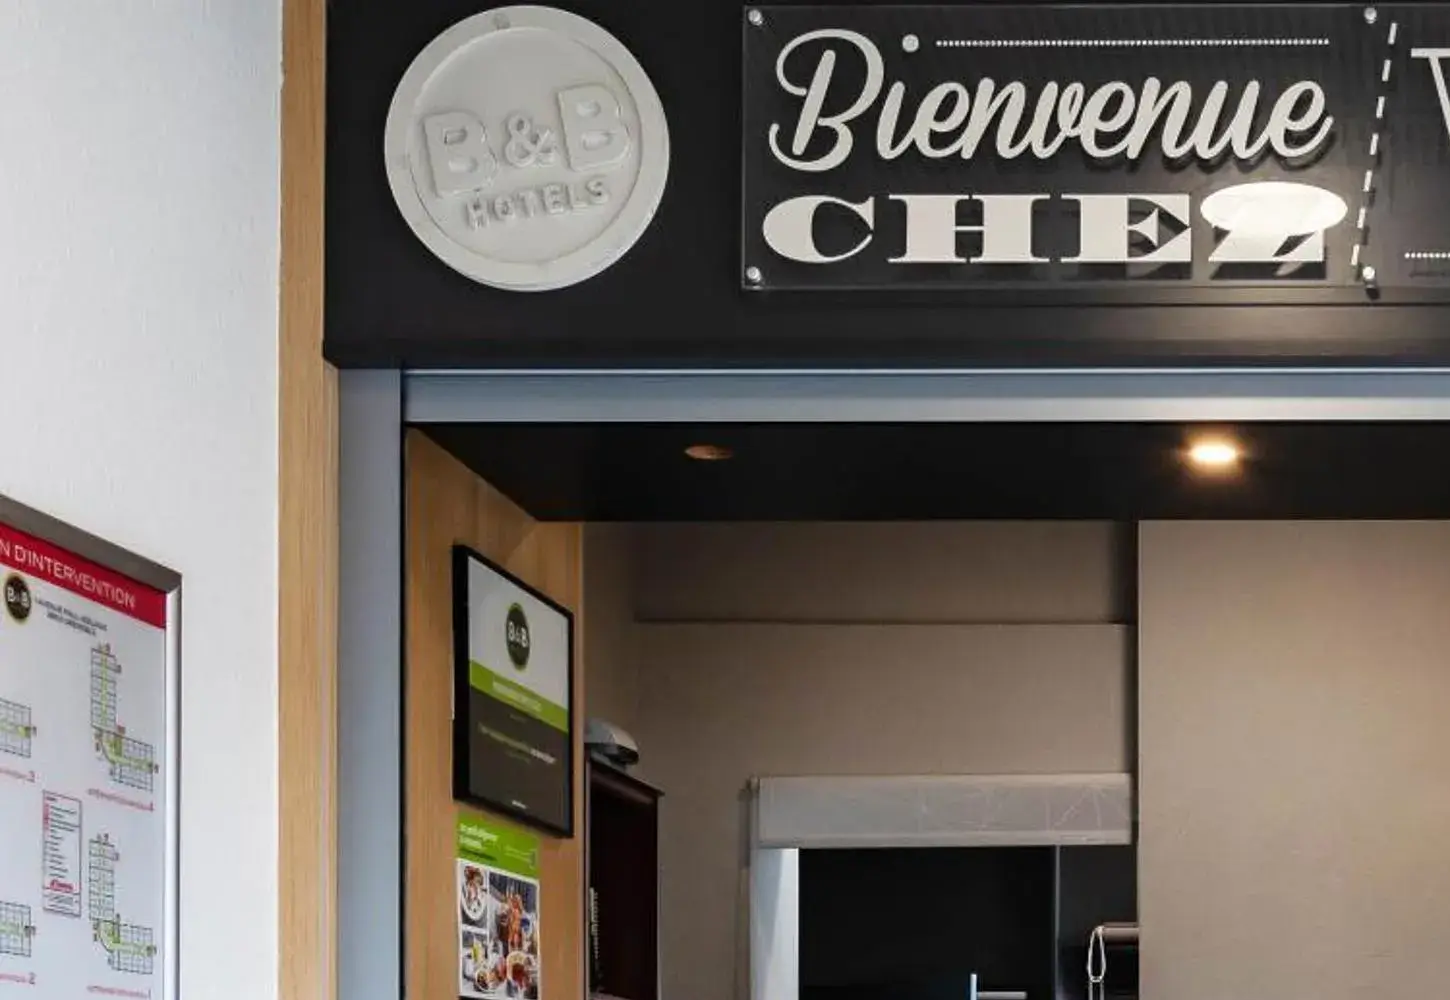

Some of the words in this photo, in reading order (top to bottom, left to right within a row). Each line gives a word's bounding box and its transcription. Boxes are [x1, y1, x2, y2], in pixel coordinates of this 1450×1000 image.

[422, 81, 635, 201] B&B
[769, 29, 1333, 170] Bienvenue
[465, 181, 609, 232] HOTELS
[762, 194, 1326, 264] CHEZ
